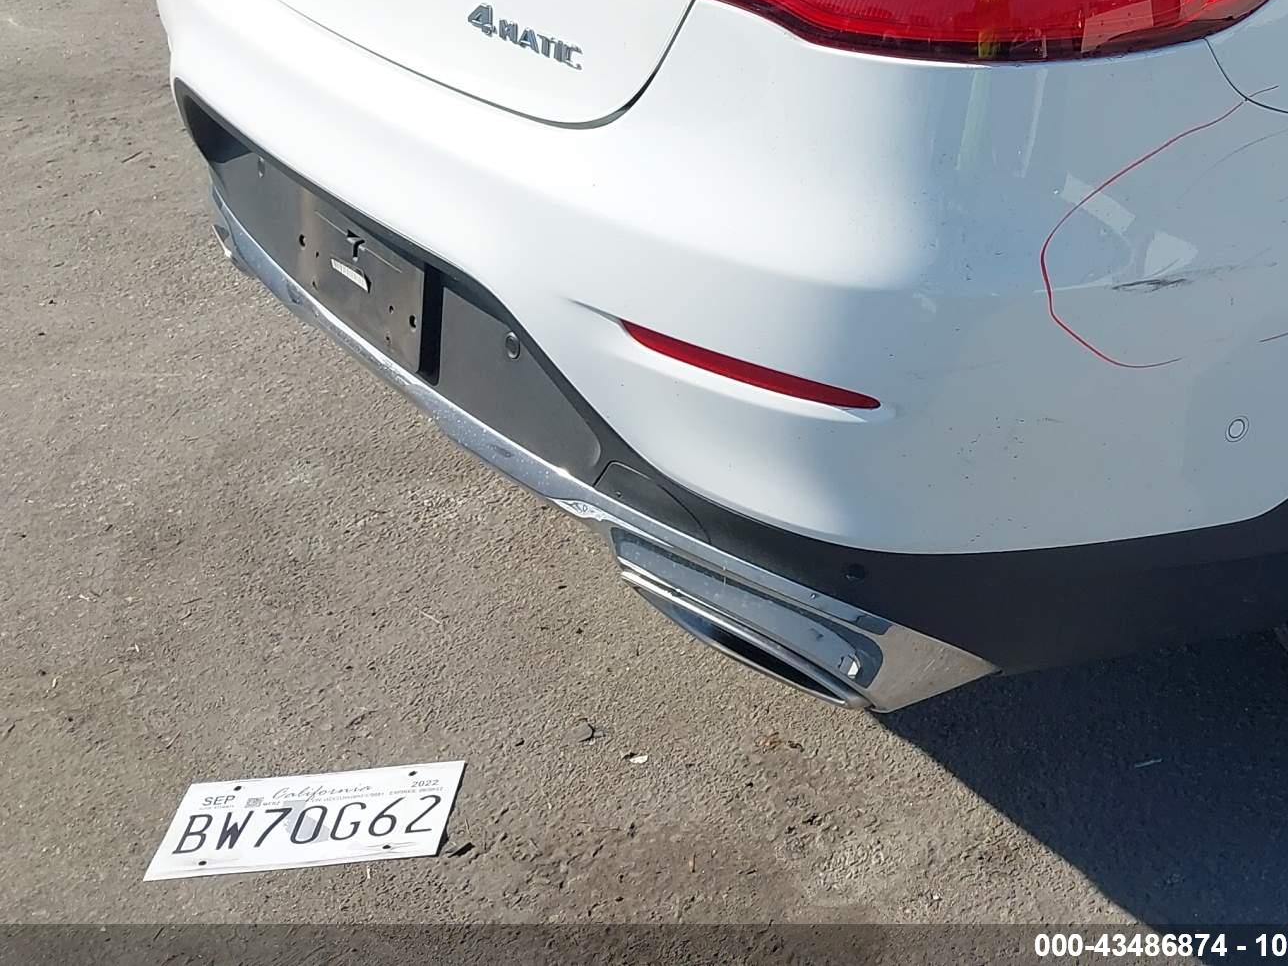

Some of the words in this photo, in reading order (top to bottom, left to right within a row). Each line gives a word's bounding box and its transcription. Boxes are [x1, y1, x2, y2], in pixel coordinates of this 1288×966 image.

[467, 3, 583, 70] 4MATIC
[411, 779, 440, 788] 2022
[202, 795, 236, 807] SEP
[272, 785, 373, 802] California
[171, 795, 443, 855] BW70G62
